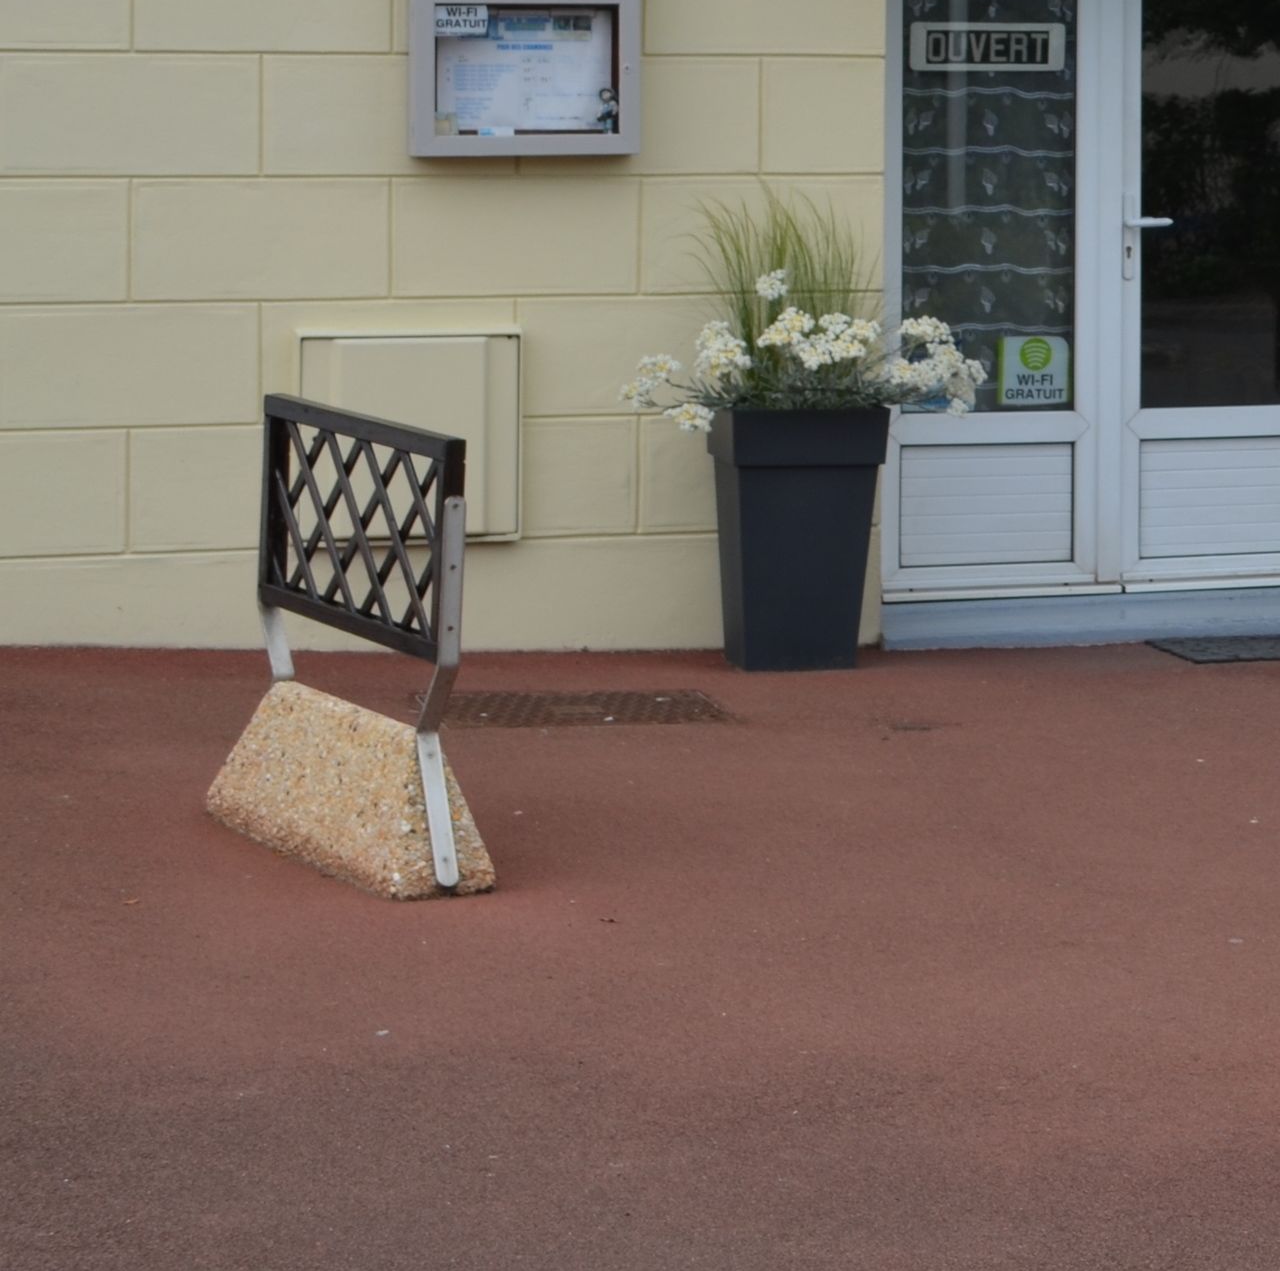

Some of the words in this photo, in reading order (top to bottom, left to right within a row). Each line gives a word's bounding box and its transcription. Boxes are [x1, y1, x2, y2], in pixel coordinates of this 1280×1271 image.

[446, 7, 478, 17] WI-FI
[436, 19, 487, 28] GRATUIT
[927, 32, 1049, 62] OUVERT
[1016, 374, 1053, 386] WI-FI
[1005, 388, 1064, 400] GRATUIT
